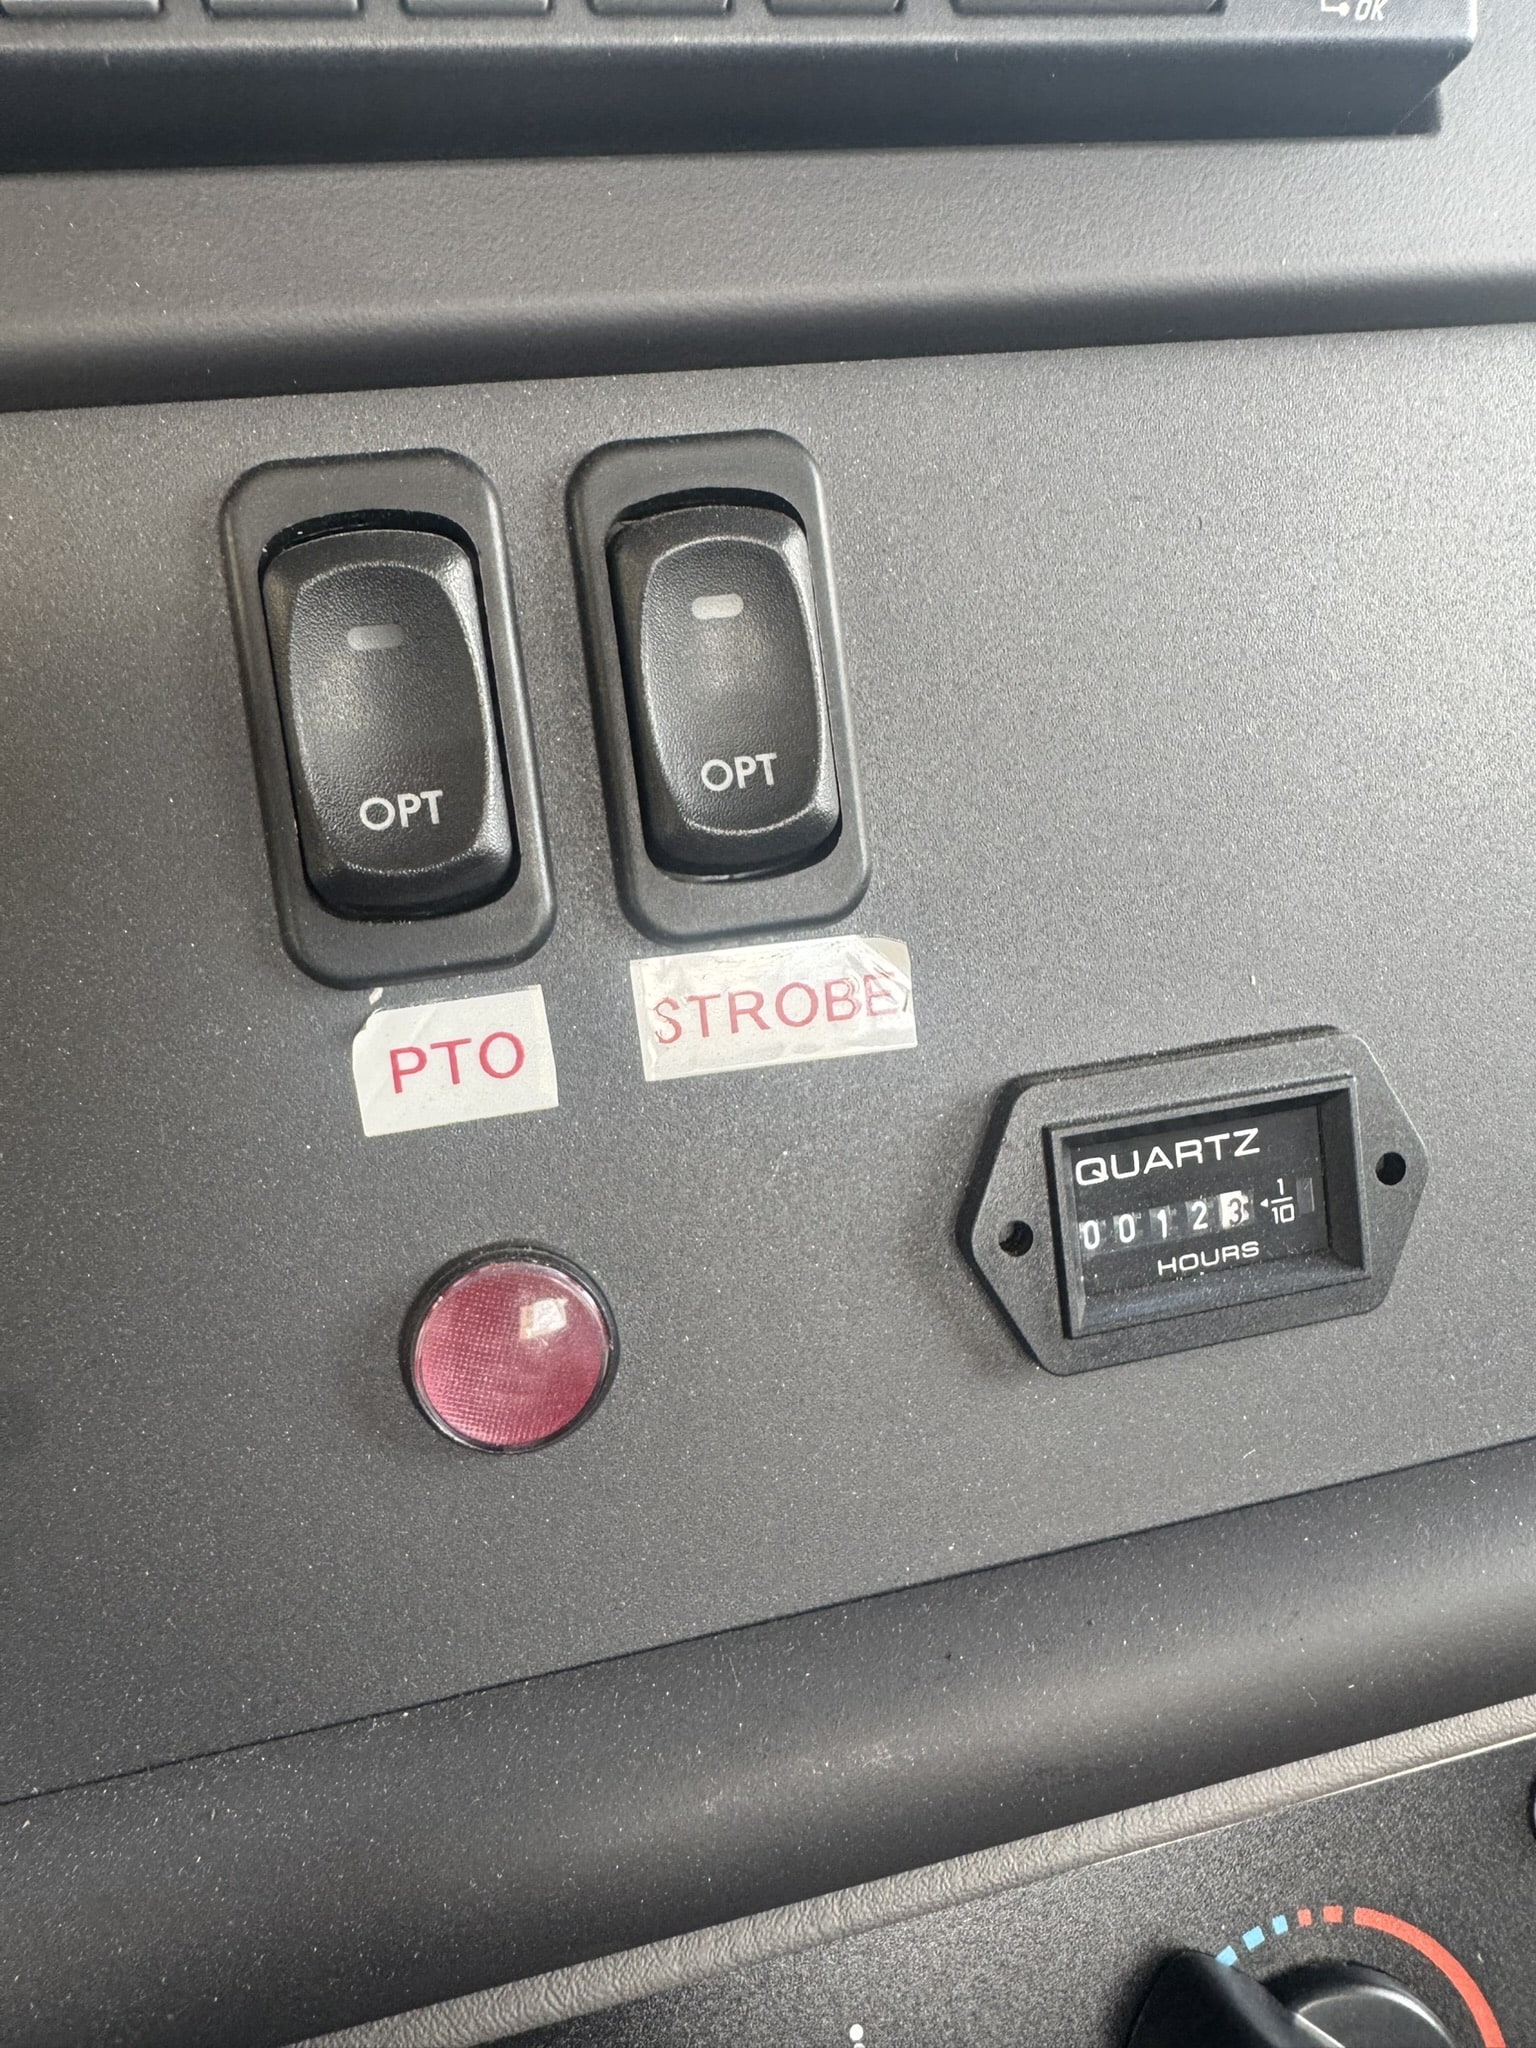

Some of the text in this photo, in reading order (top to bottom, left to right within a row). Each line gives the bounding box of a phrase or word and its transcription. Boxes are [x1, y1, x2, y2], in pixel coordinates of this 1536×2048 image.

[1354, 0, 1386, 21] OK
[701, 752, 778, 792] OPT
[359, 790, 443, 831] OPT
[654, 971, 898, 1044] STROBE
[389, 1031, 525, 1094] PTO
[1075, 1127, 1261, 1186] QUARTZ
[1157, 1240, 1260, 1276] HOURS
